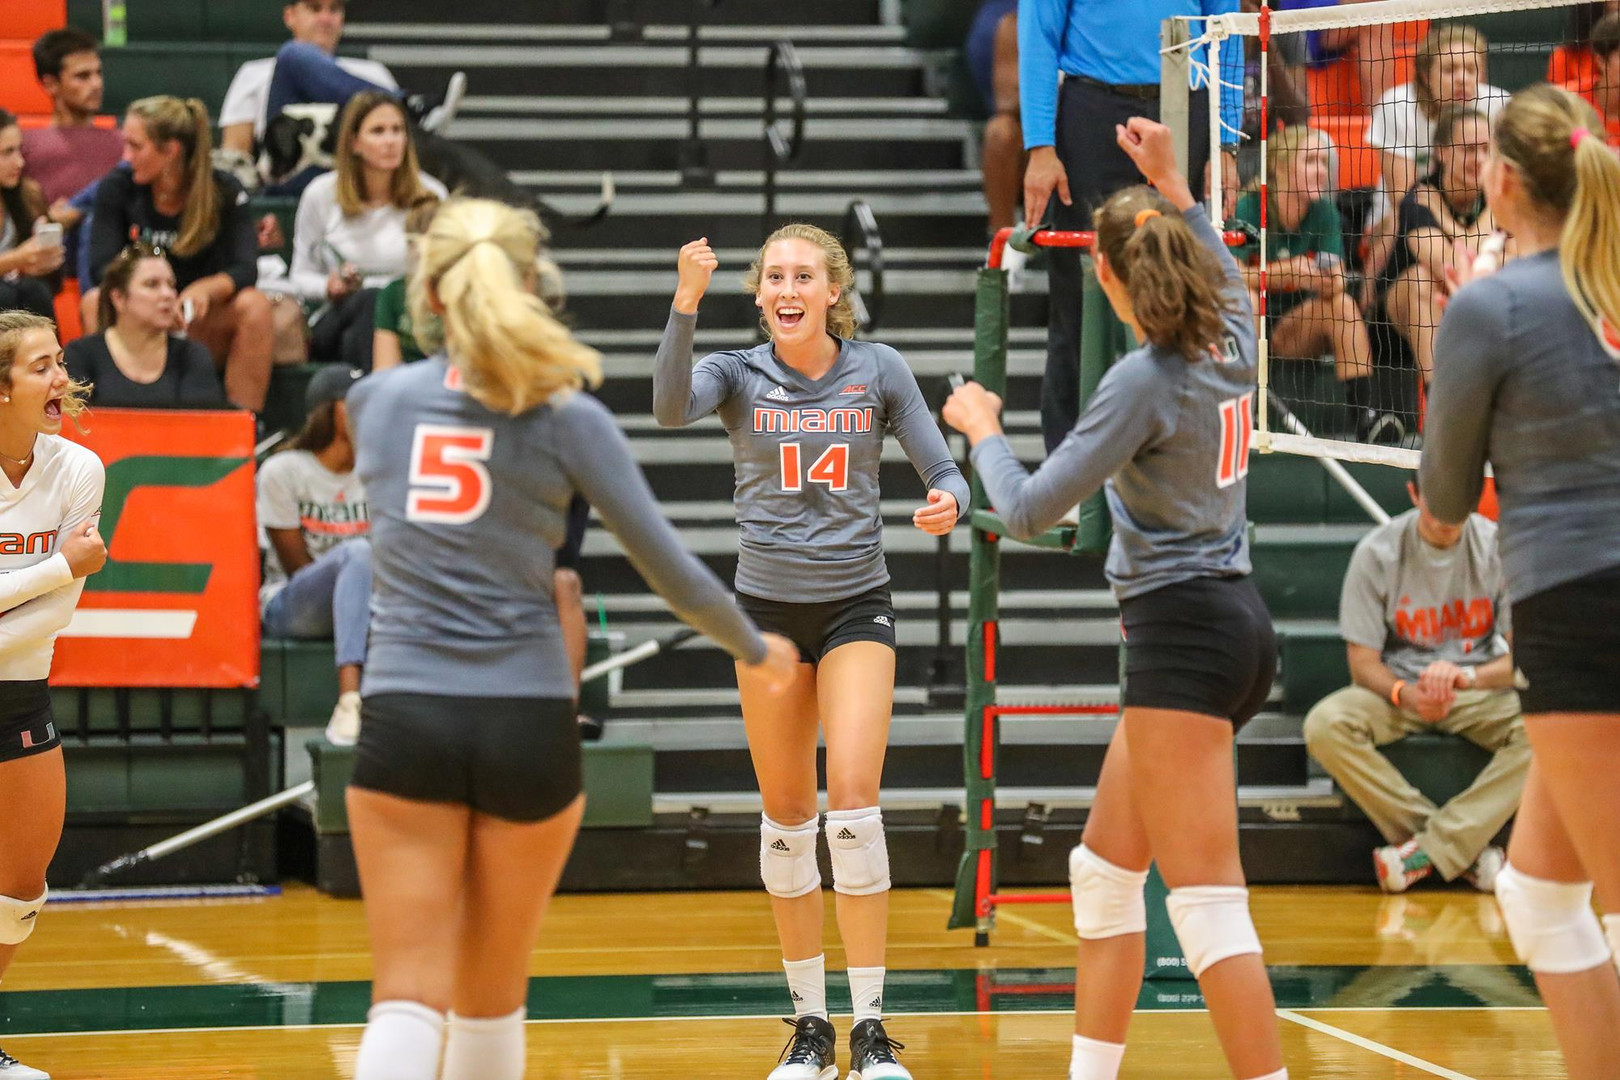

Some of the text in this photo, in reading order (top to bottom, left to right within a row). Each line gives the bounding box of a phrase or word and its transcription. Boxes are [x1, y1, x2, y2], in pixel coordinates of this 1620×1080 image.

[406, 423, 494, 525] 5
[779, 442, 850, 492] 14
[1216, 392, 1254, 489] 11
